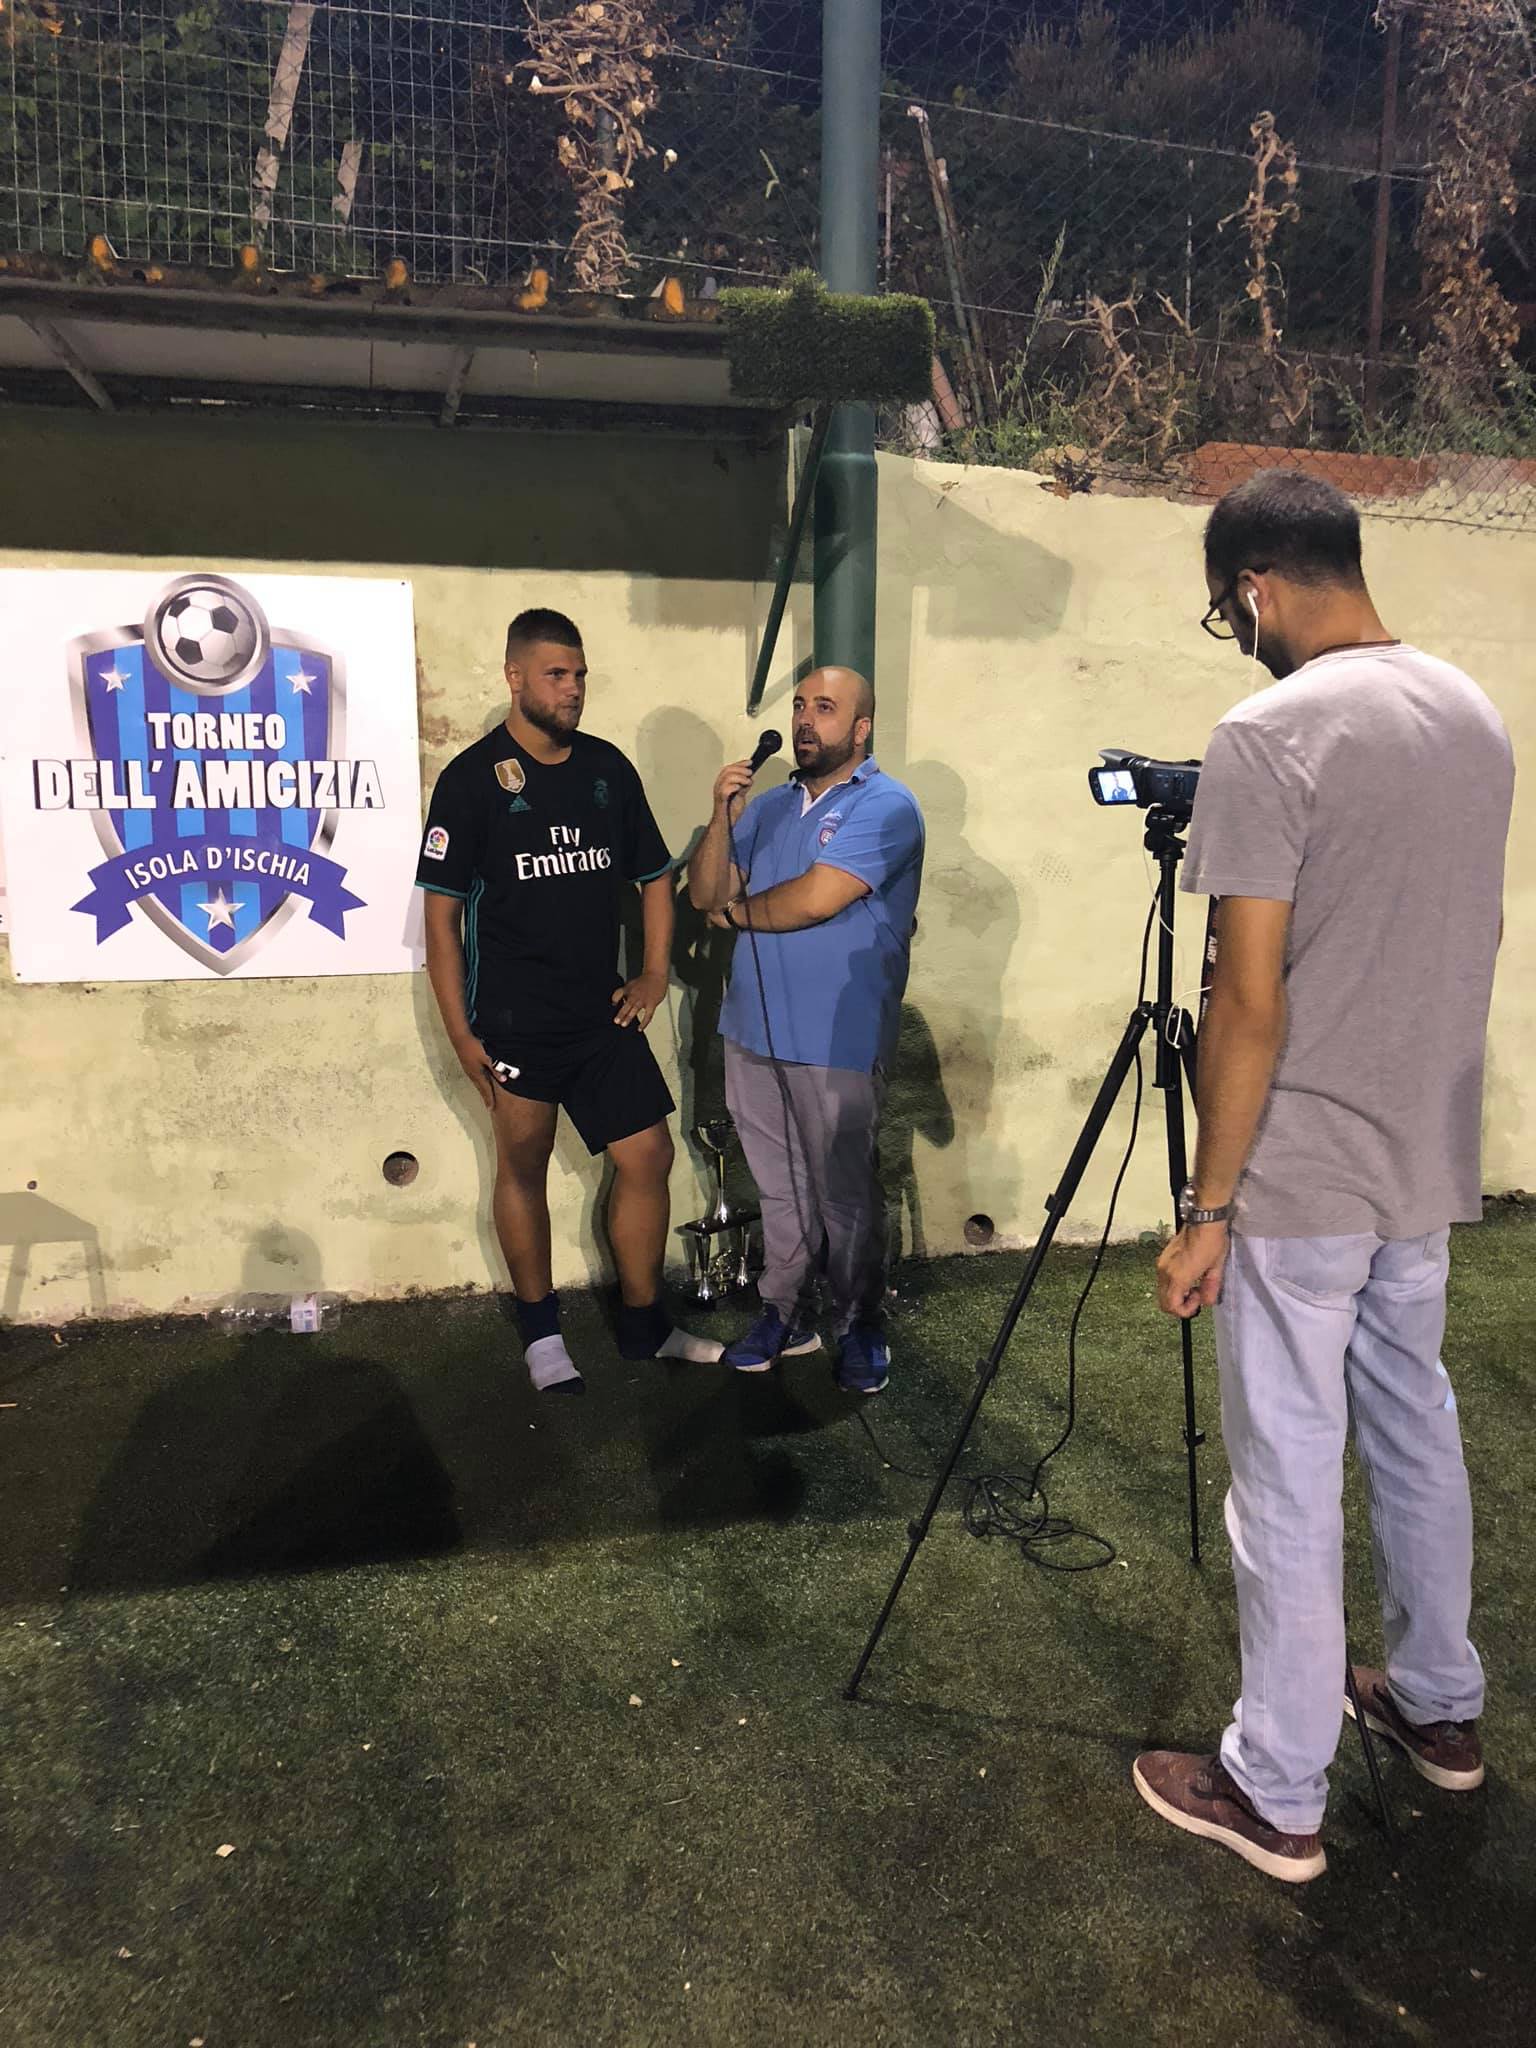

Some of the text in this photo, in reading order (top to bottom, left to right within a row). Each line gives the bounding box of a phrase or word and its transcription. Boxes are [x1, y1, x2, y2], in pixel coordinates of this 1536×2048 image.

[147, 712, 287, 750] TORNEO
[33, 759, 385, 810] DELL'AMICIZIA
[549, 825, 581, 847] Fly
[124, 846, 310, 890] ISOLA D'ISCHIA
[514, 846, 612, 881] Emirates
